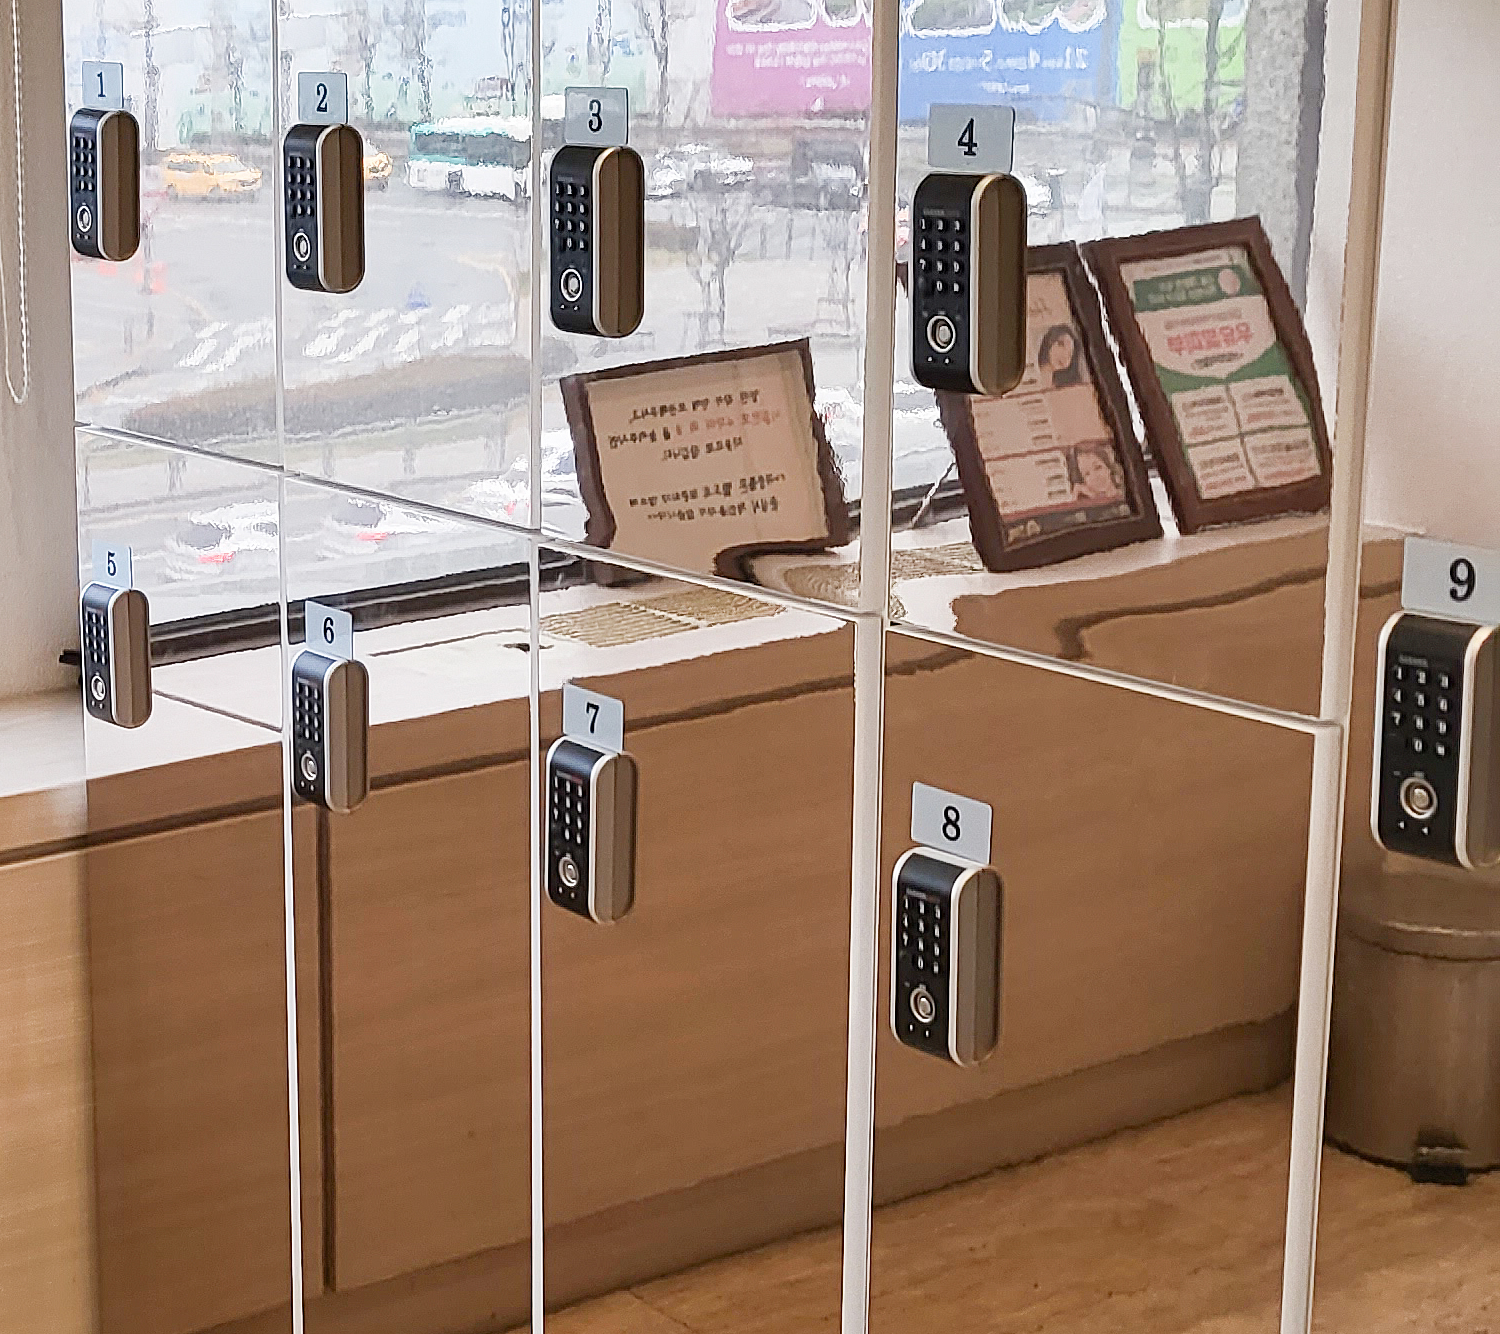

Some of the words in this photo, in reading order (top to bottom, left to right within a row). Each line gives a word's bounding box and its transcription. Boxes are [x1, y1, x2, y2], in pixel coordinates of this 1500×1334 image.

[97, 71, 106, 98] 1
[316, 82, 328, 112] 2
[588, 99, 602, 133] 3
[957, 117, 978, 156] 4
[107, 551, 117, 577] 5
[1449, 558, 1476, 603] 9
[323, 617, 335, 644] 6
[586, 701, 600, 734] 7
[942, 805, 961, 842] 8
